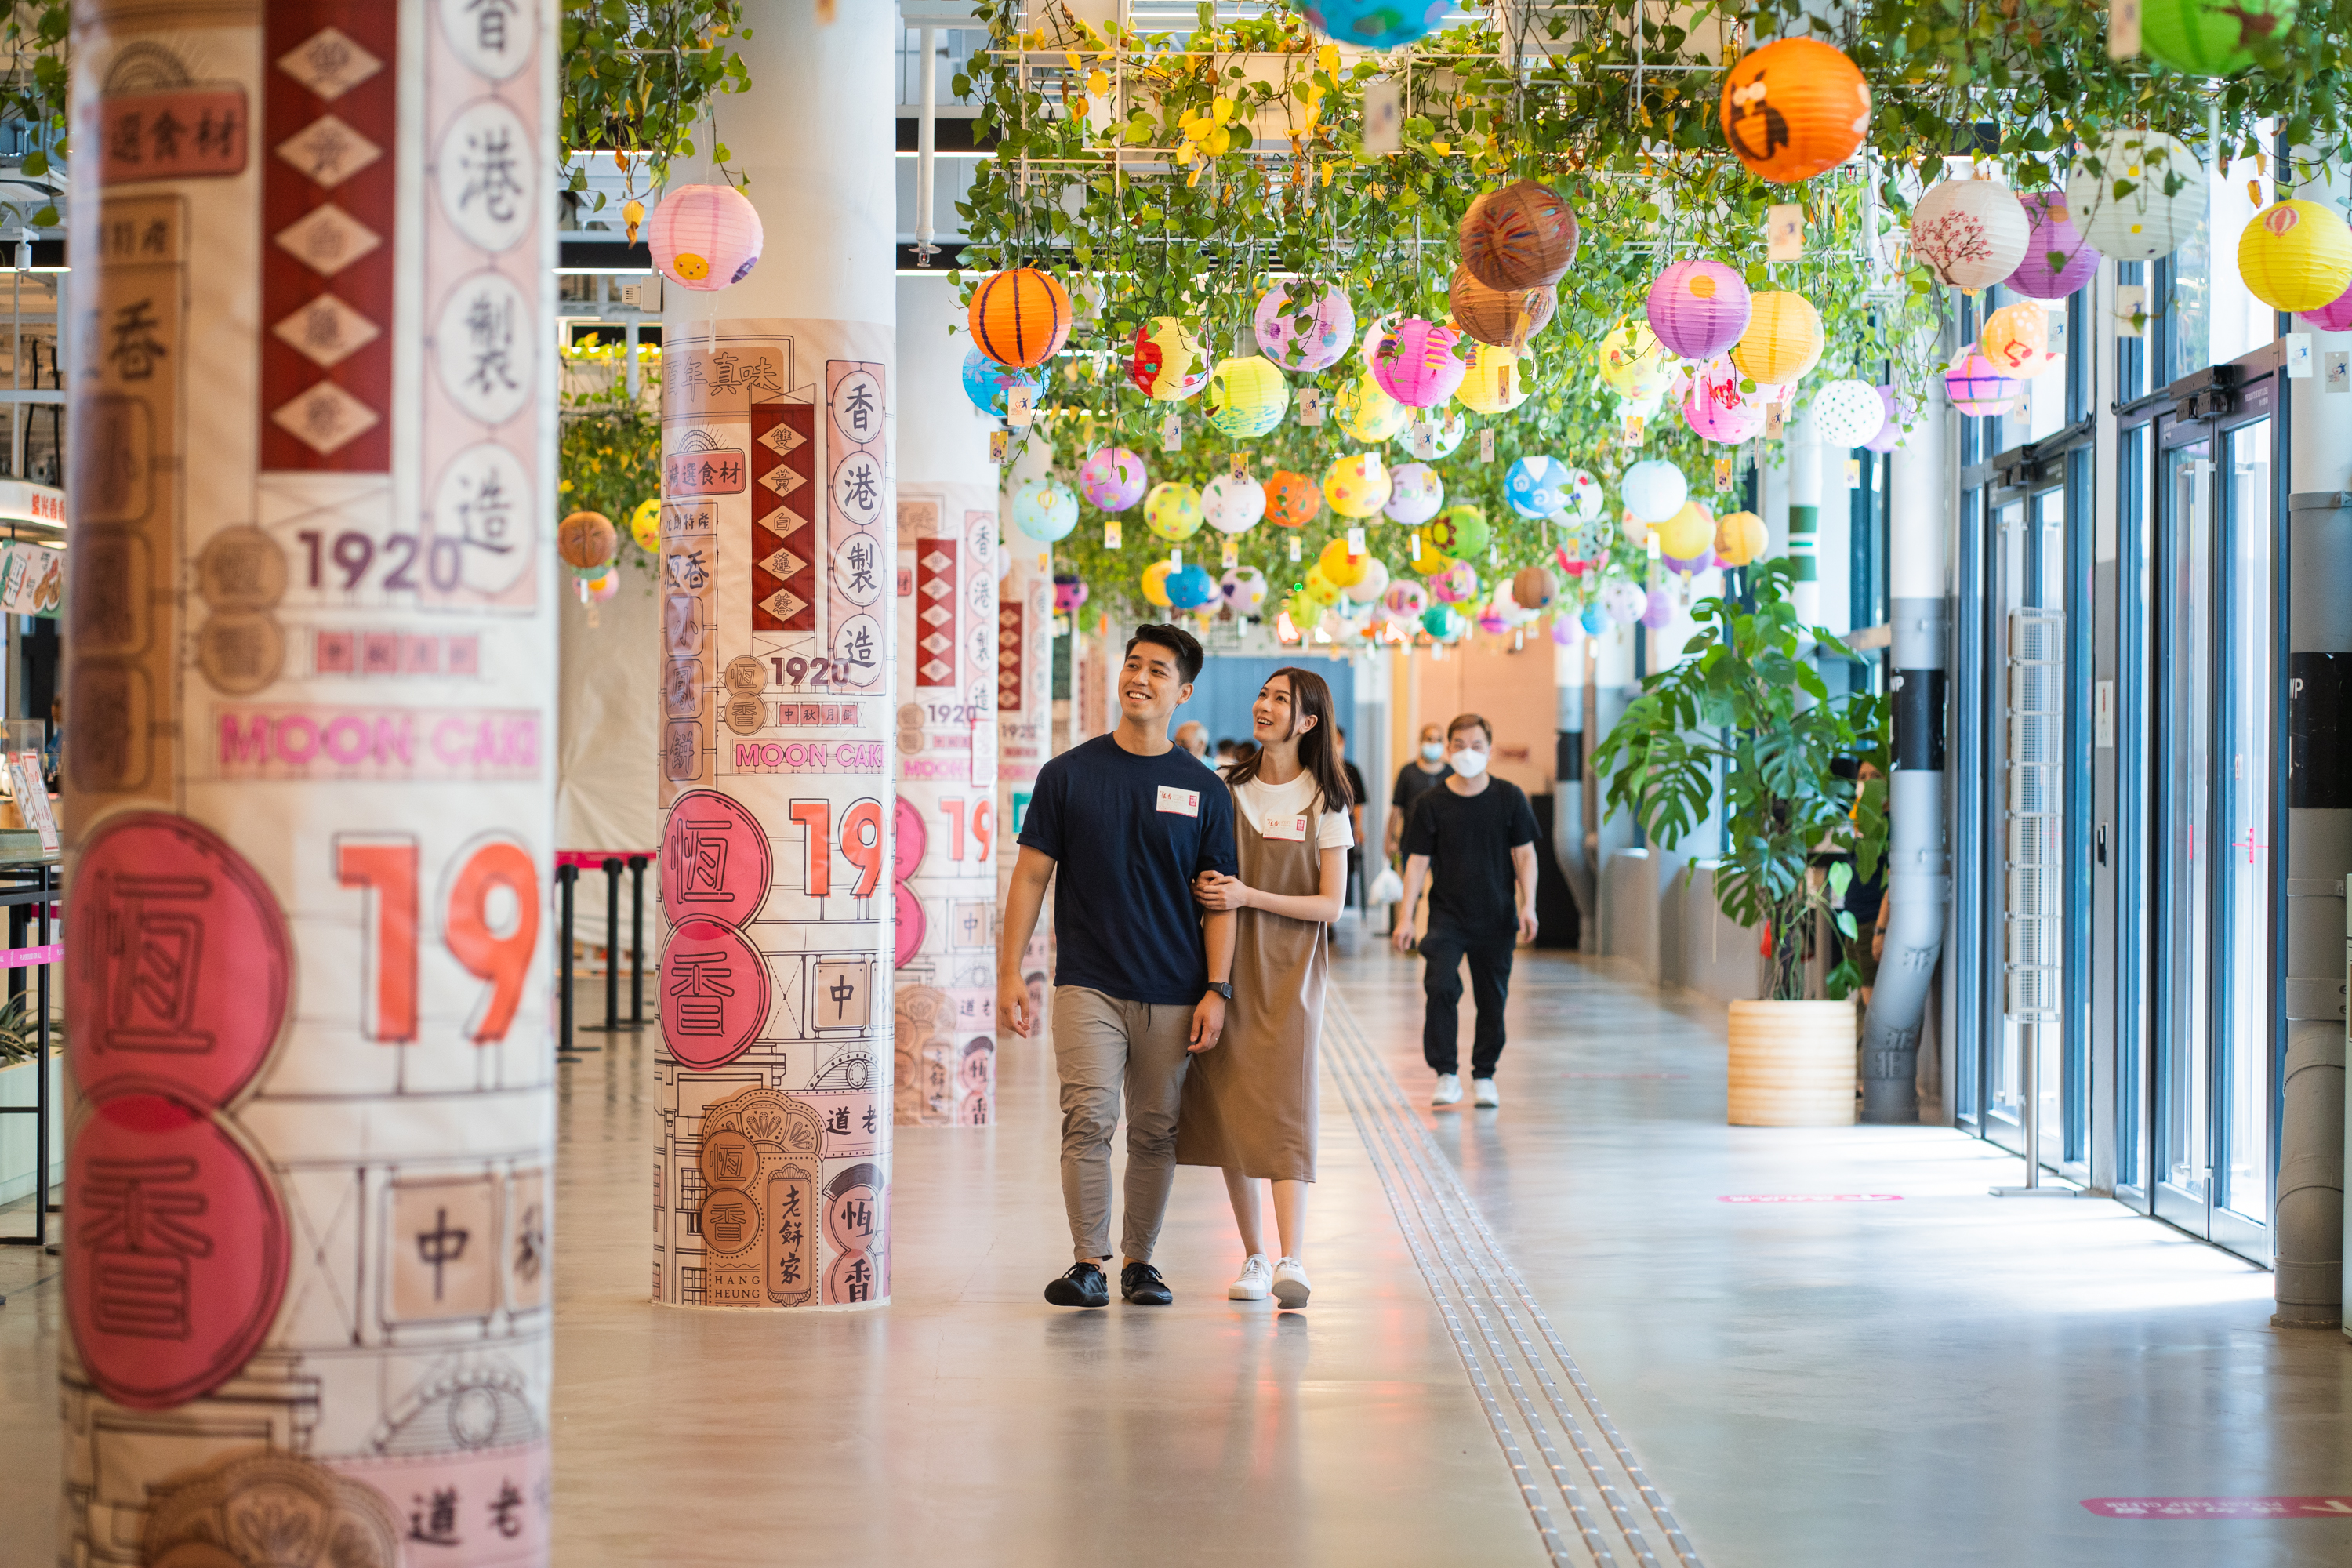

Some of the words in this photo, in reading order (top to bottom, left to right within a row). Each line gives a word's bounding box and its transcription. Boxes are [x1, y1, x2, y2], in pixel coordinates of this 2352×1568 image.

[666, 351, 782, 402] 百年真味
[668, 461, 742, 488] 精選食材
[844, 384, 878, 669] 香港製造
[297, 530, 464, 593] 1920
[974, 525, 990, 712] 香港製造
[770, 657, 850, 687] 1920
[670, 606, 699, 774] 小鳳餅
[784, 708, 853, 722] 中秋月餅
[928, 705, 976, 722] 1920
[220, 713, 416, 768] MOON
[430, 717, 538, 768] CAK
[735, 743, 828, 768] MOON
[836, 743, 884, 768] CAK
[904, 760, 963, 776] MOON
[779, 1185, 804, 1284] 老餅家
[714, 1276, 760, 1285] HANG
[714, 1289, 760, 1298] HEUNG
